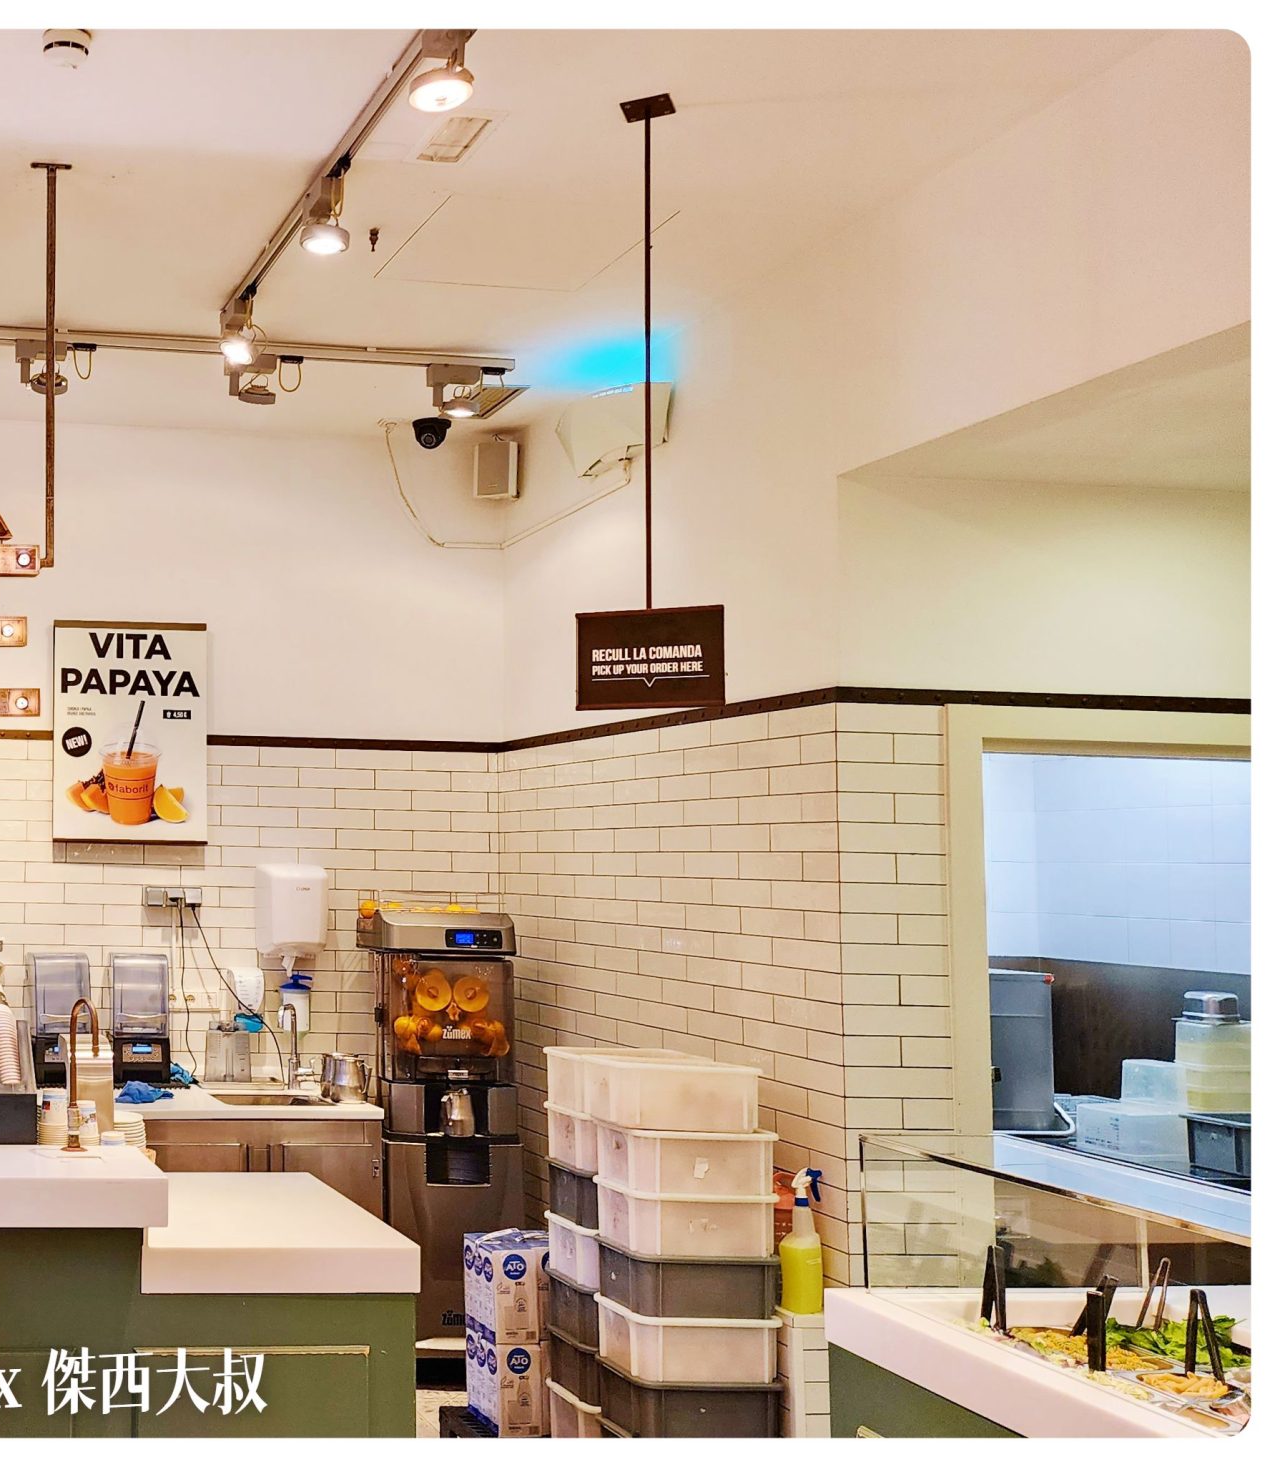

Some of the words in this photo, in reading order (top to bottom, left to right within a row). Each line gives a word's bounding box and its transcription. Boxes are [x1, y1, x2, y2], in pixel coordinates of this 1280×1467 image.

[88, 632, 172, 660] VITA
[592, 648, 631, 662] RECULL
[633, 647, 647, 660] LA
[648, 645, 702, 659] COMANDA
[592, 664, 611, 676] PICK
[612, 664, 624, 675] UP
[625, 663, 649, 674] YOUR
[649, 662, 679, 673] ORDER
[680, 661, 703, 672] HERE
[61, 667, 200, 697] PAPAYA
[65, 734, 89, 750] NEW!
[115, 782, 149, 794] faborit
[505, 1261, 524, 1271] ATO
[510, 1354, 528, 1366] ATO
